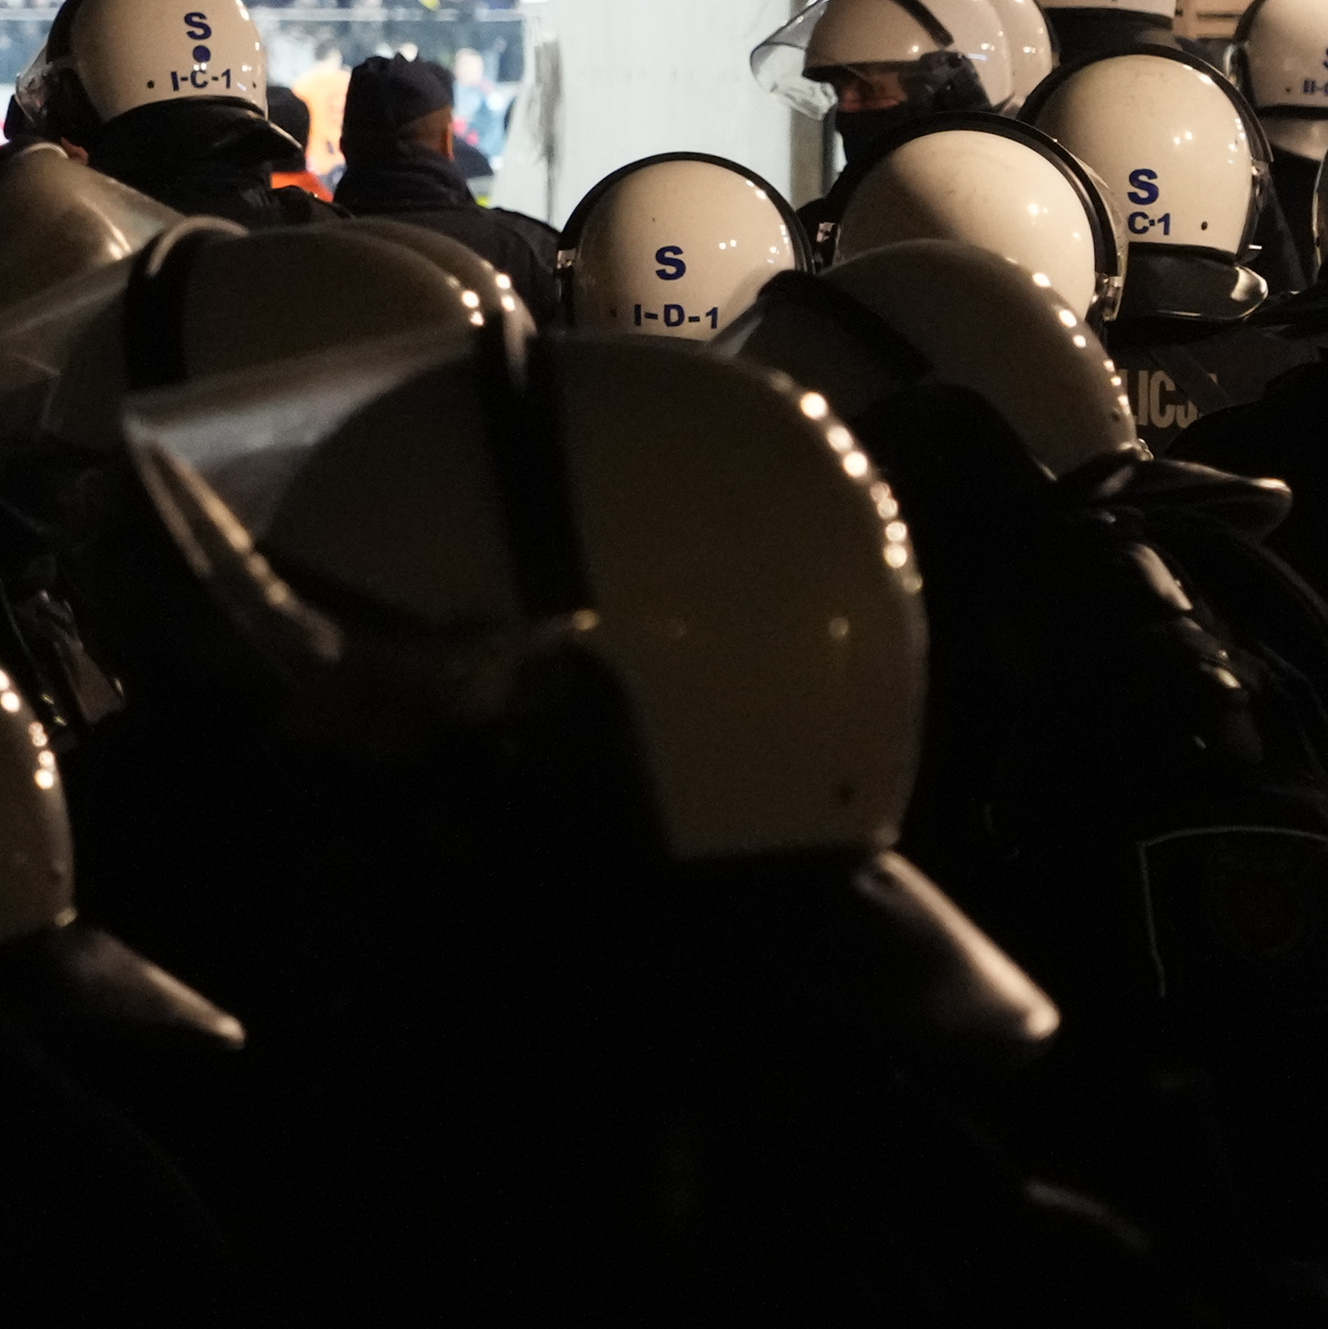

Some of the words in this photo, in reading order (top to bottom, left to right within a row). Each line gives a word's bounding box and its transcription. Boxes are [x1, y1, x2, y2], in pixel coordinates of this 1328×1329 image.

[184, 12, 212, 40] S
[171, 68, 231, 91] I-C-1
[1127, 168, 1159, 205] S
[655, 245, 686, 281] S
[634, 303, 718, 329] I-D-1
